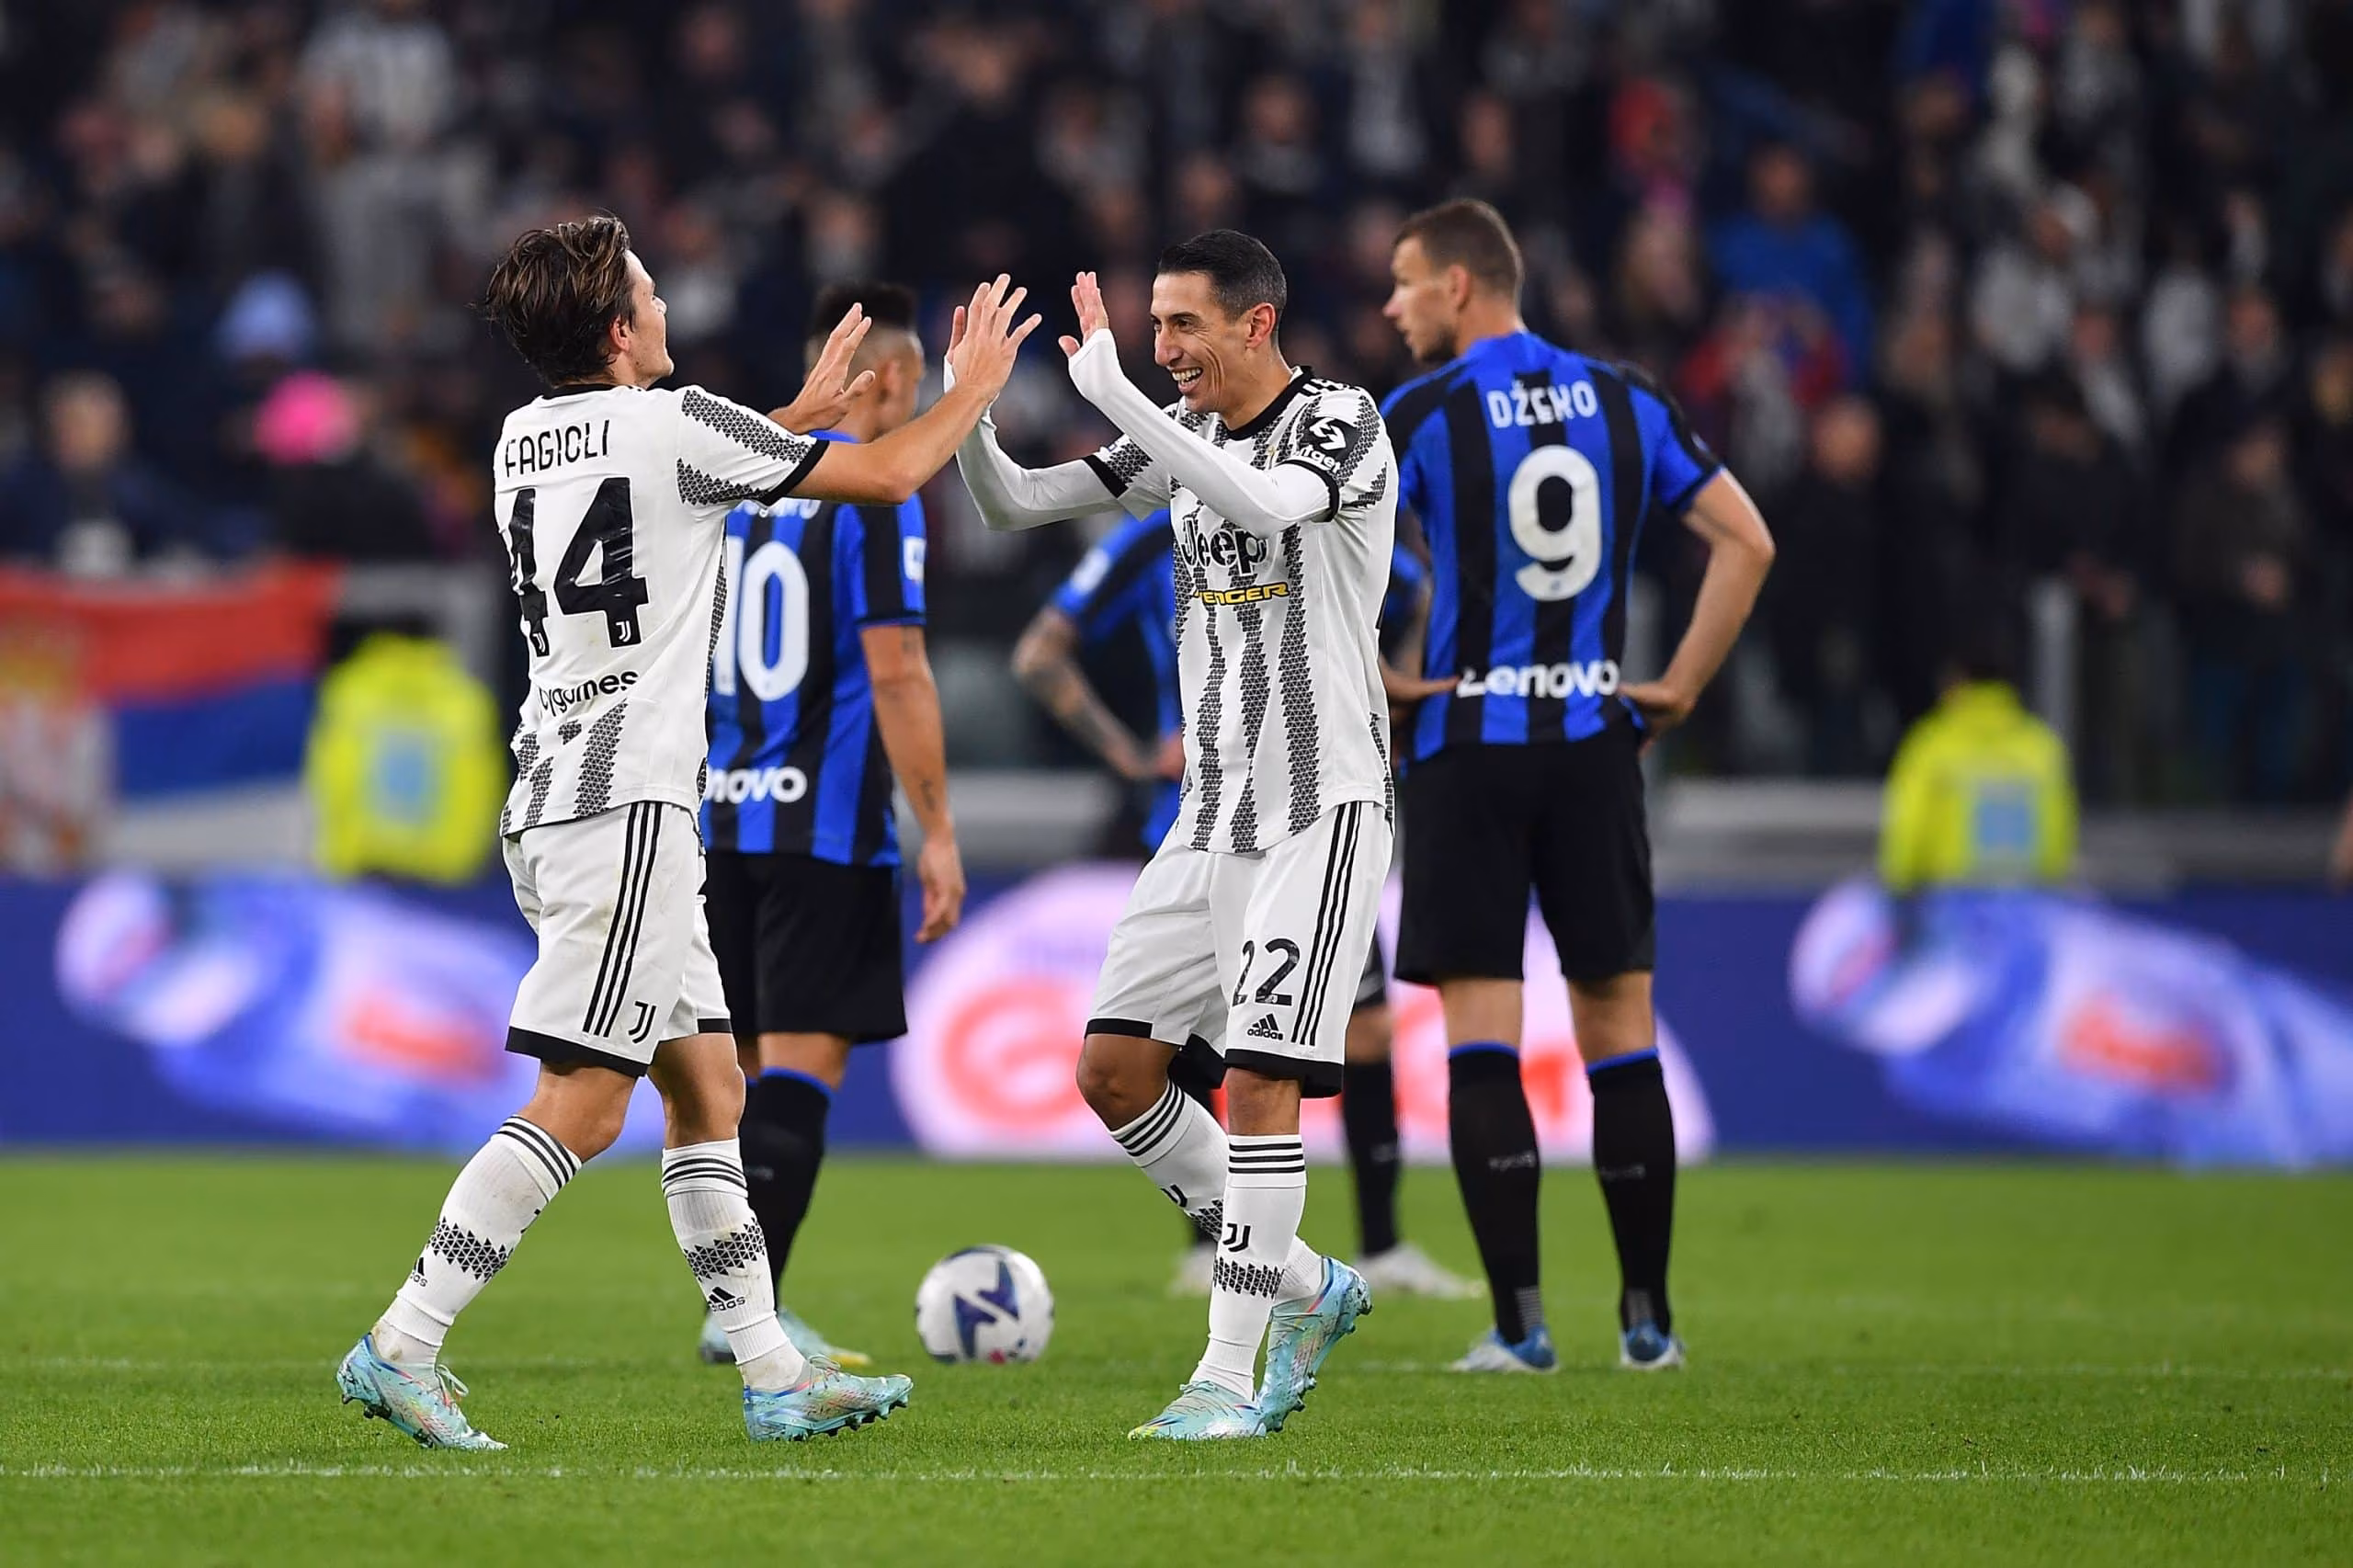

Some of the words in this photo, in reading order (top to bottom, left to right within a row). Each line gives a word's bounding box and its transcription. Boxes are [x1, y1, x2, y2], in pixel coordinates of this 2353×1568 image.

[1486, 380, 1598, 429] DŽEKO
[505, 419, 609, 478] FAGIOLI
[1180, 517, 1267, 576] Jeep
[1507, 444, 1602, 601] 9
[508, 477, 650, 658] 44
[713, 534, 810, 702] 10
[1456, 659, 1620, 699] Lenovo
[706, 766, 809, 803] novo
[1233, 937, 1301, 1006] 22
[1247, 1028, 1284, 1041] adidas
